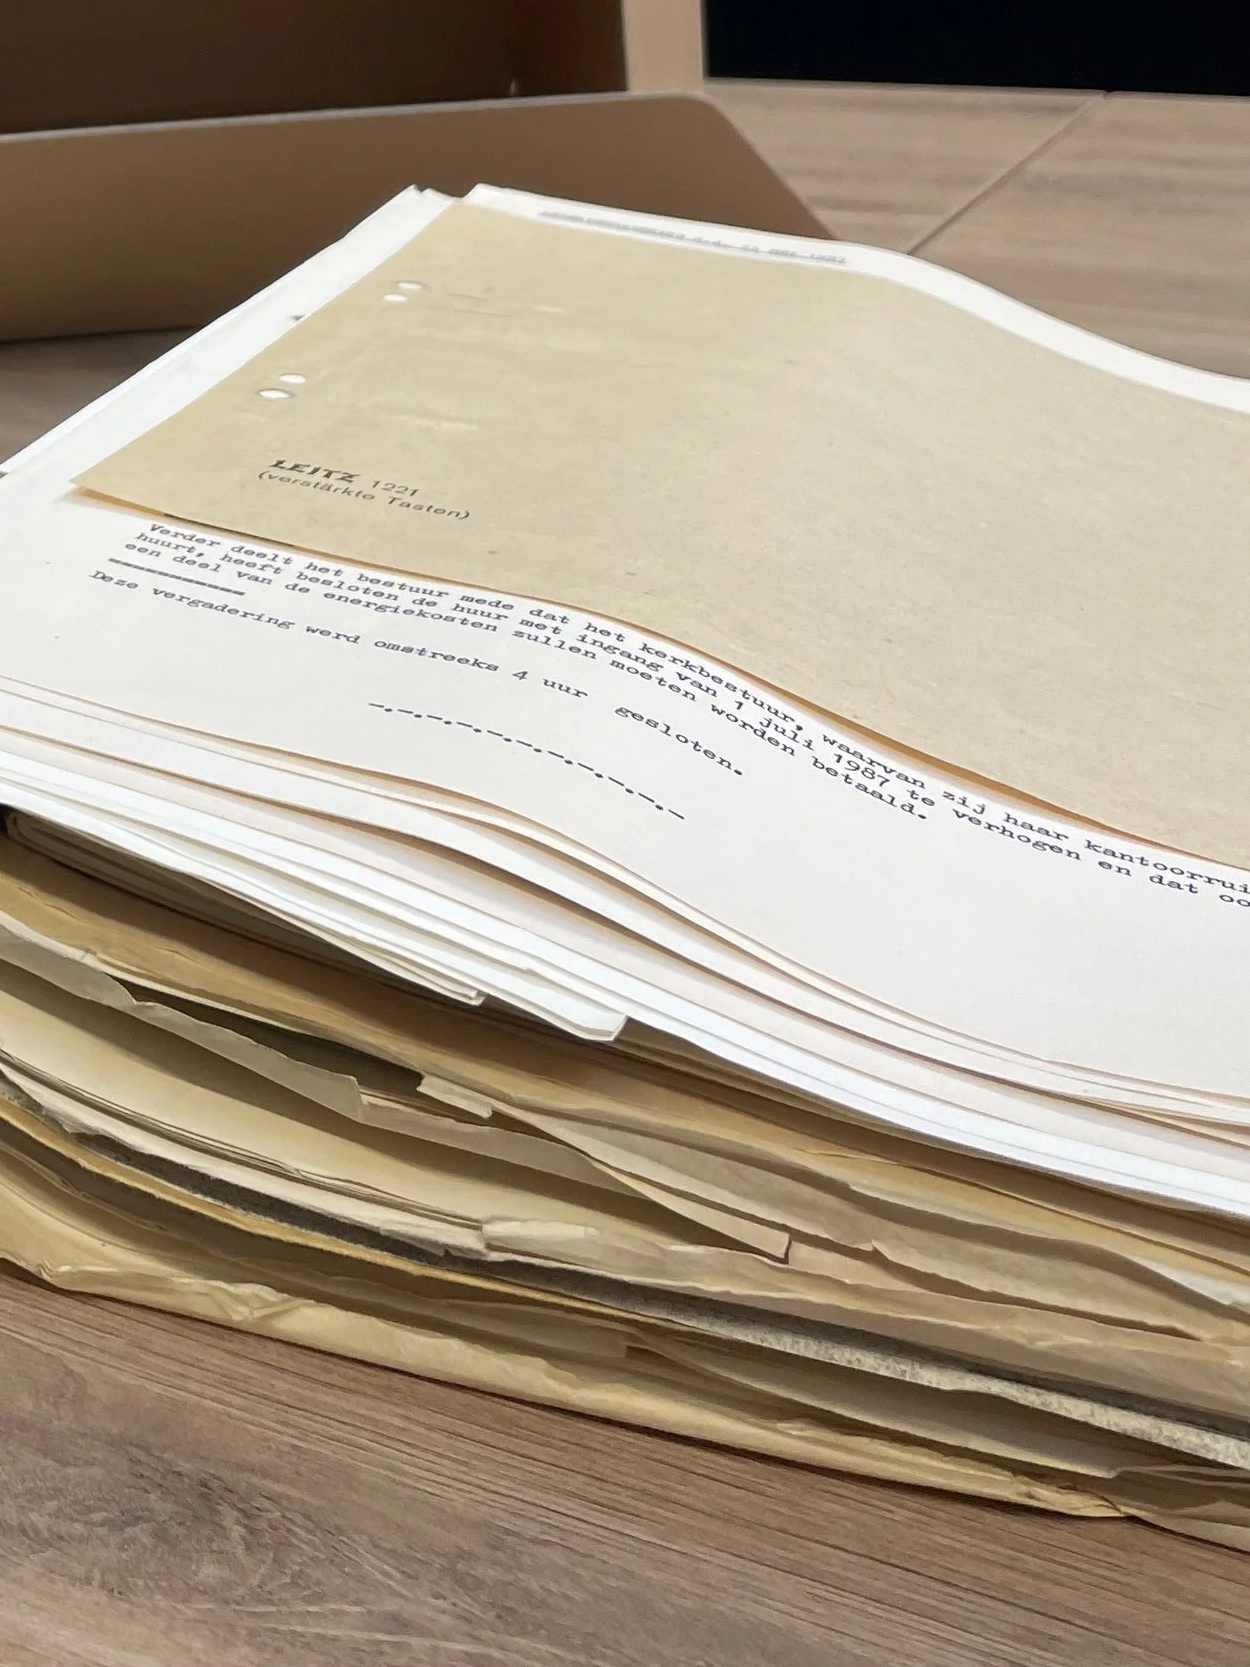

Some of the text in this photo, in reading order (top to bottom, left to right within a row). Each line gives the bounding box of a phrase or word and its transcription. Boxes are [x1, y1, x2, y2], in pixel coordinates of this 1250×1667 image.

[258, 471, 470, 520] (verstärkte Tasten)
[268, 459, 419, 496] LEITZ 1221
[89, 570, 742, 776] Deze vergadering werd omstreeks 4 uur gesloten.
[125, 542, 927, 820] een deel van de energiekosten zullen moeten worden betaald.
[134, 532, 204, 557] huurt,
[220, 553, 283, 575] heeft
[296, 571, 399, 601] besloten
[412, 597, 438, 608] de
[451, 603, 508, 621] huur
[519, 618, 562, 635] met
[576, 634, 664, 673] ingang
[676, 671, 718, 698] van
[734, 700, 744, 710] 1
[759, 717, 814, 751] juli
[834, 753, 890, 787] 1987
[906, 789, 935, 807] te
[952, 808, 1081, 861] verhogen
[1098, 860, 1132, 877] en
[1149, 874, 1198, 894] dat
[149, 523, 1250, 895] Verder deelt het bestuur mede dat het kerkbestuur, waarvan zij haar kantoorrui
